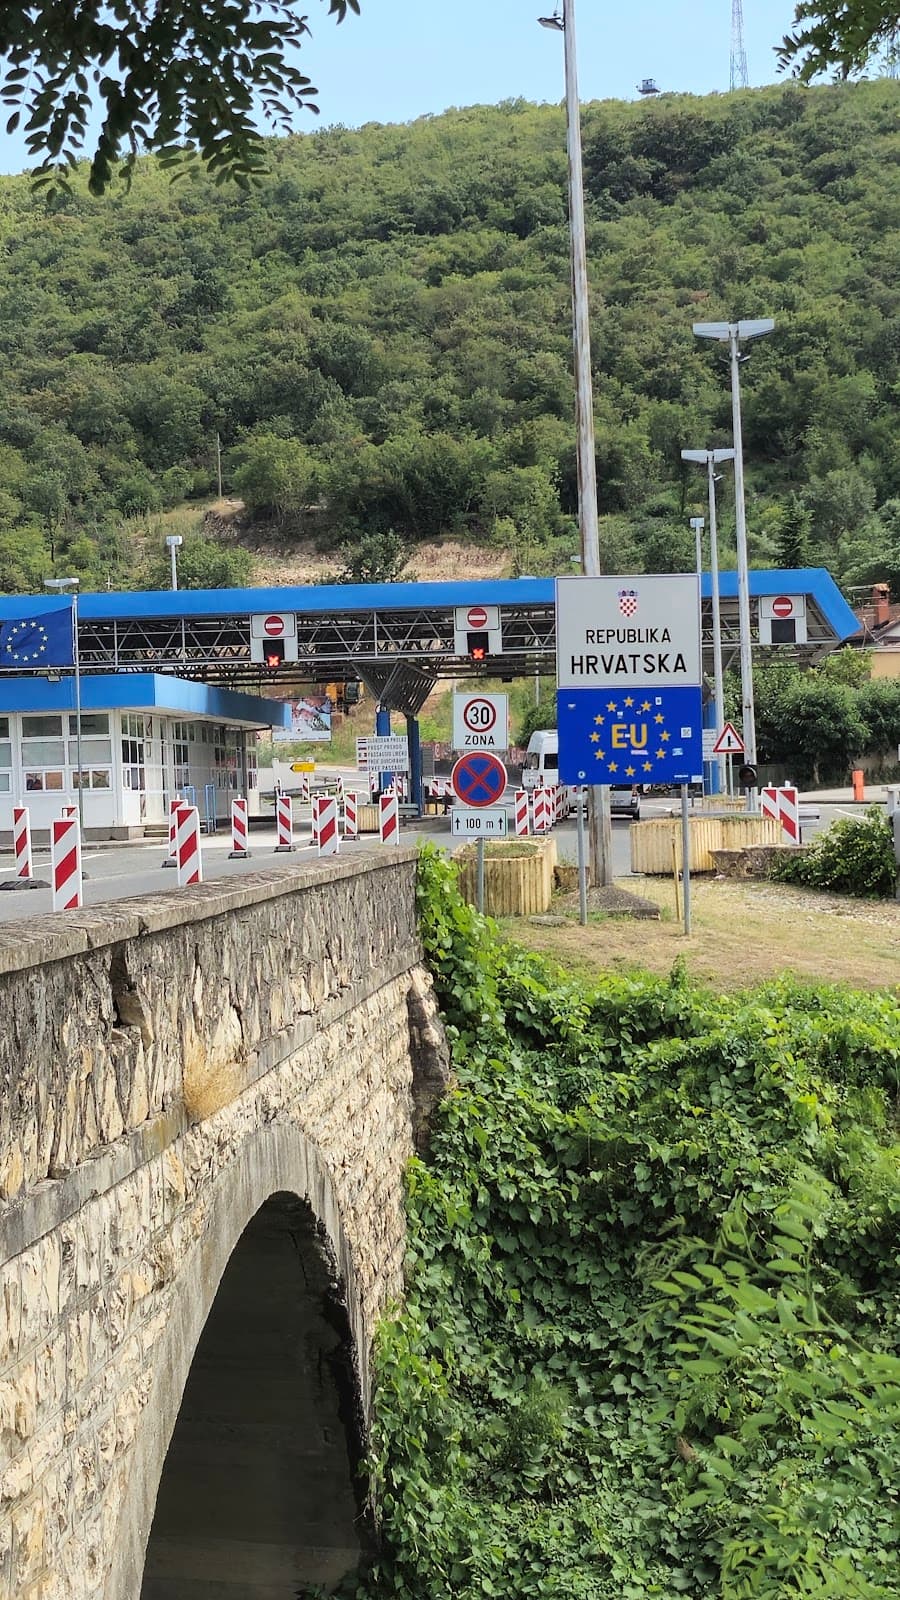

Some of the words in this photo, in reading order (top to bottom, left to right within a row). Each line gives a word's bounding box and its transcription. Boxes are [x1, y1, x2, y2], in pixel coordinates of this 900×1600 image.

[586, 628, 671, 644] REPUBLIKA
[571, 653, 687, 675] HRVATSKA
[470, 706, 490, 725] 30
[464, 735, 495, 746] ZONA
[611, 723, 648, 749] EU
[466, 818, 481, 829] 100
[486, 820, 494, 829] m
